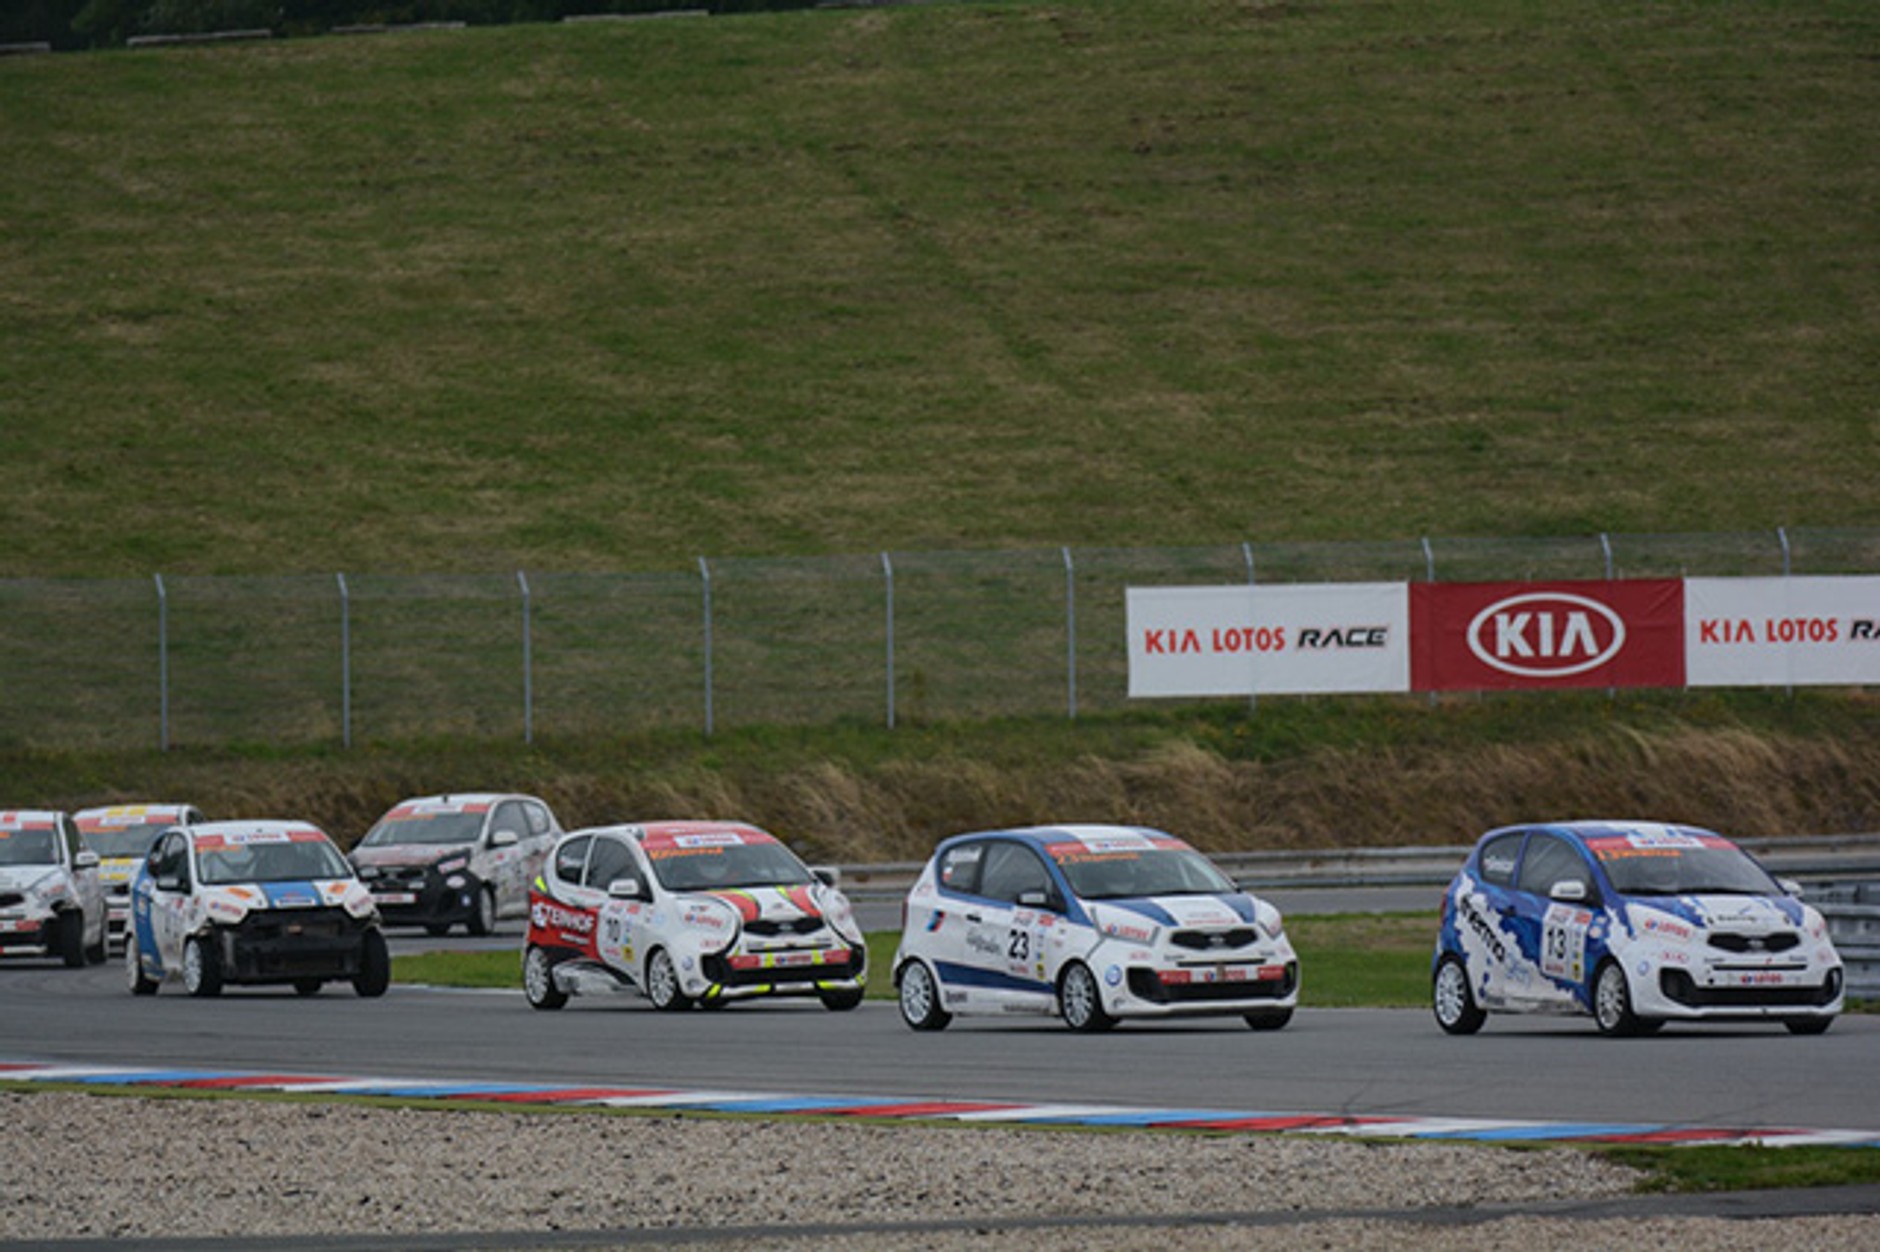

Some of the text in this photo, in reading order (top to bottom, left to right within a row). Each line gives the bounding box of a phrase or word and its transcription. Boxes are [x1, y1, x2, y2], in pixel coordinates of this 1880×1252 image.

[1145, 627, 1387, 653] KIA LOTOS RACE
[1495, 612, 1599, 657] KIA
[1700, 619, 1755, 643] KIA
[1766, 618, 1838, 643] LOTOS
[1008, 929, 1029, 960] 23
[1547, 927, 1567, 960] 13
